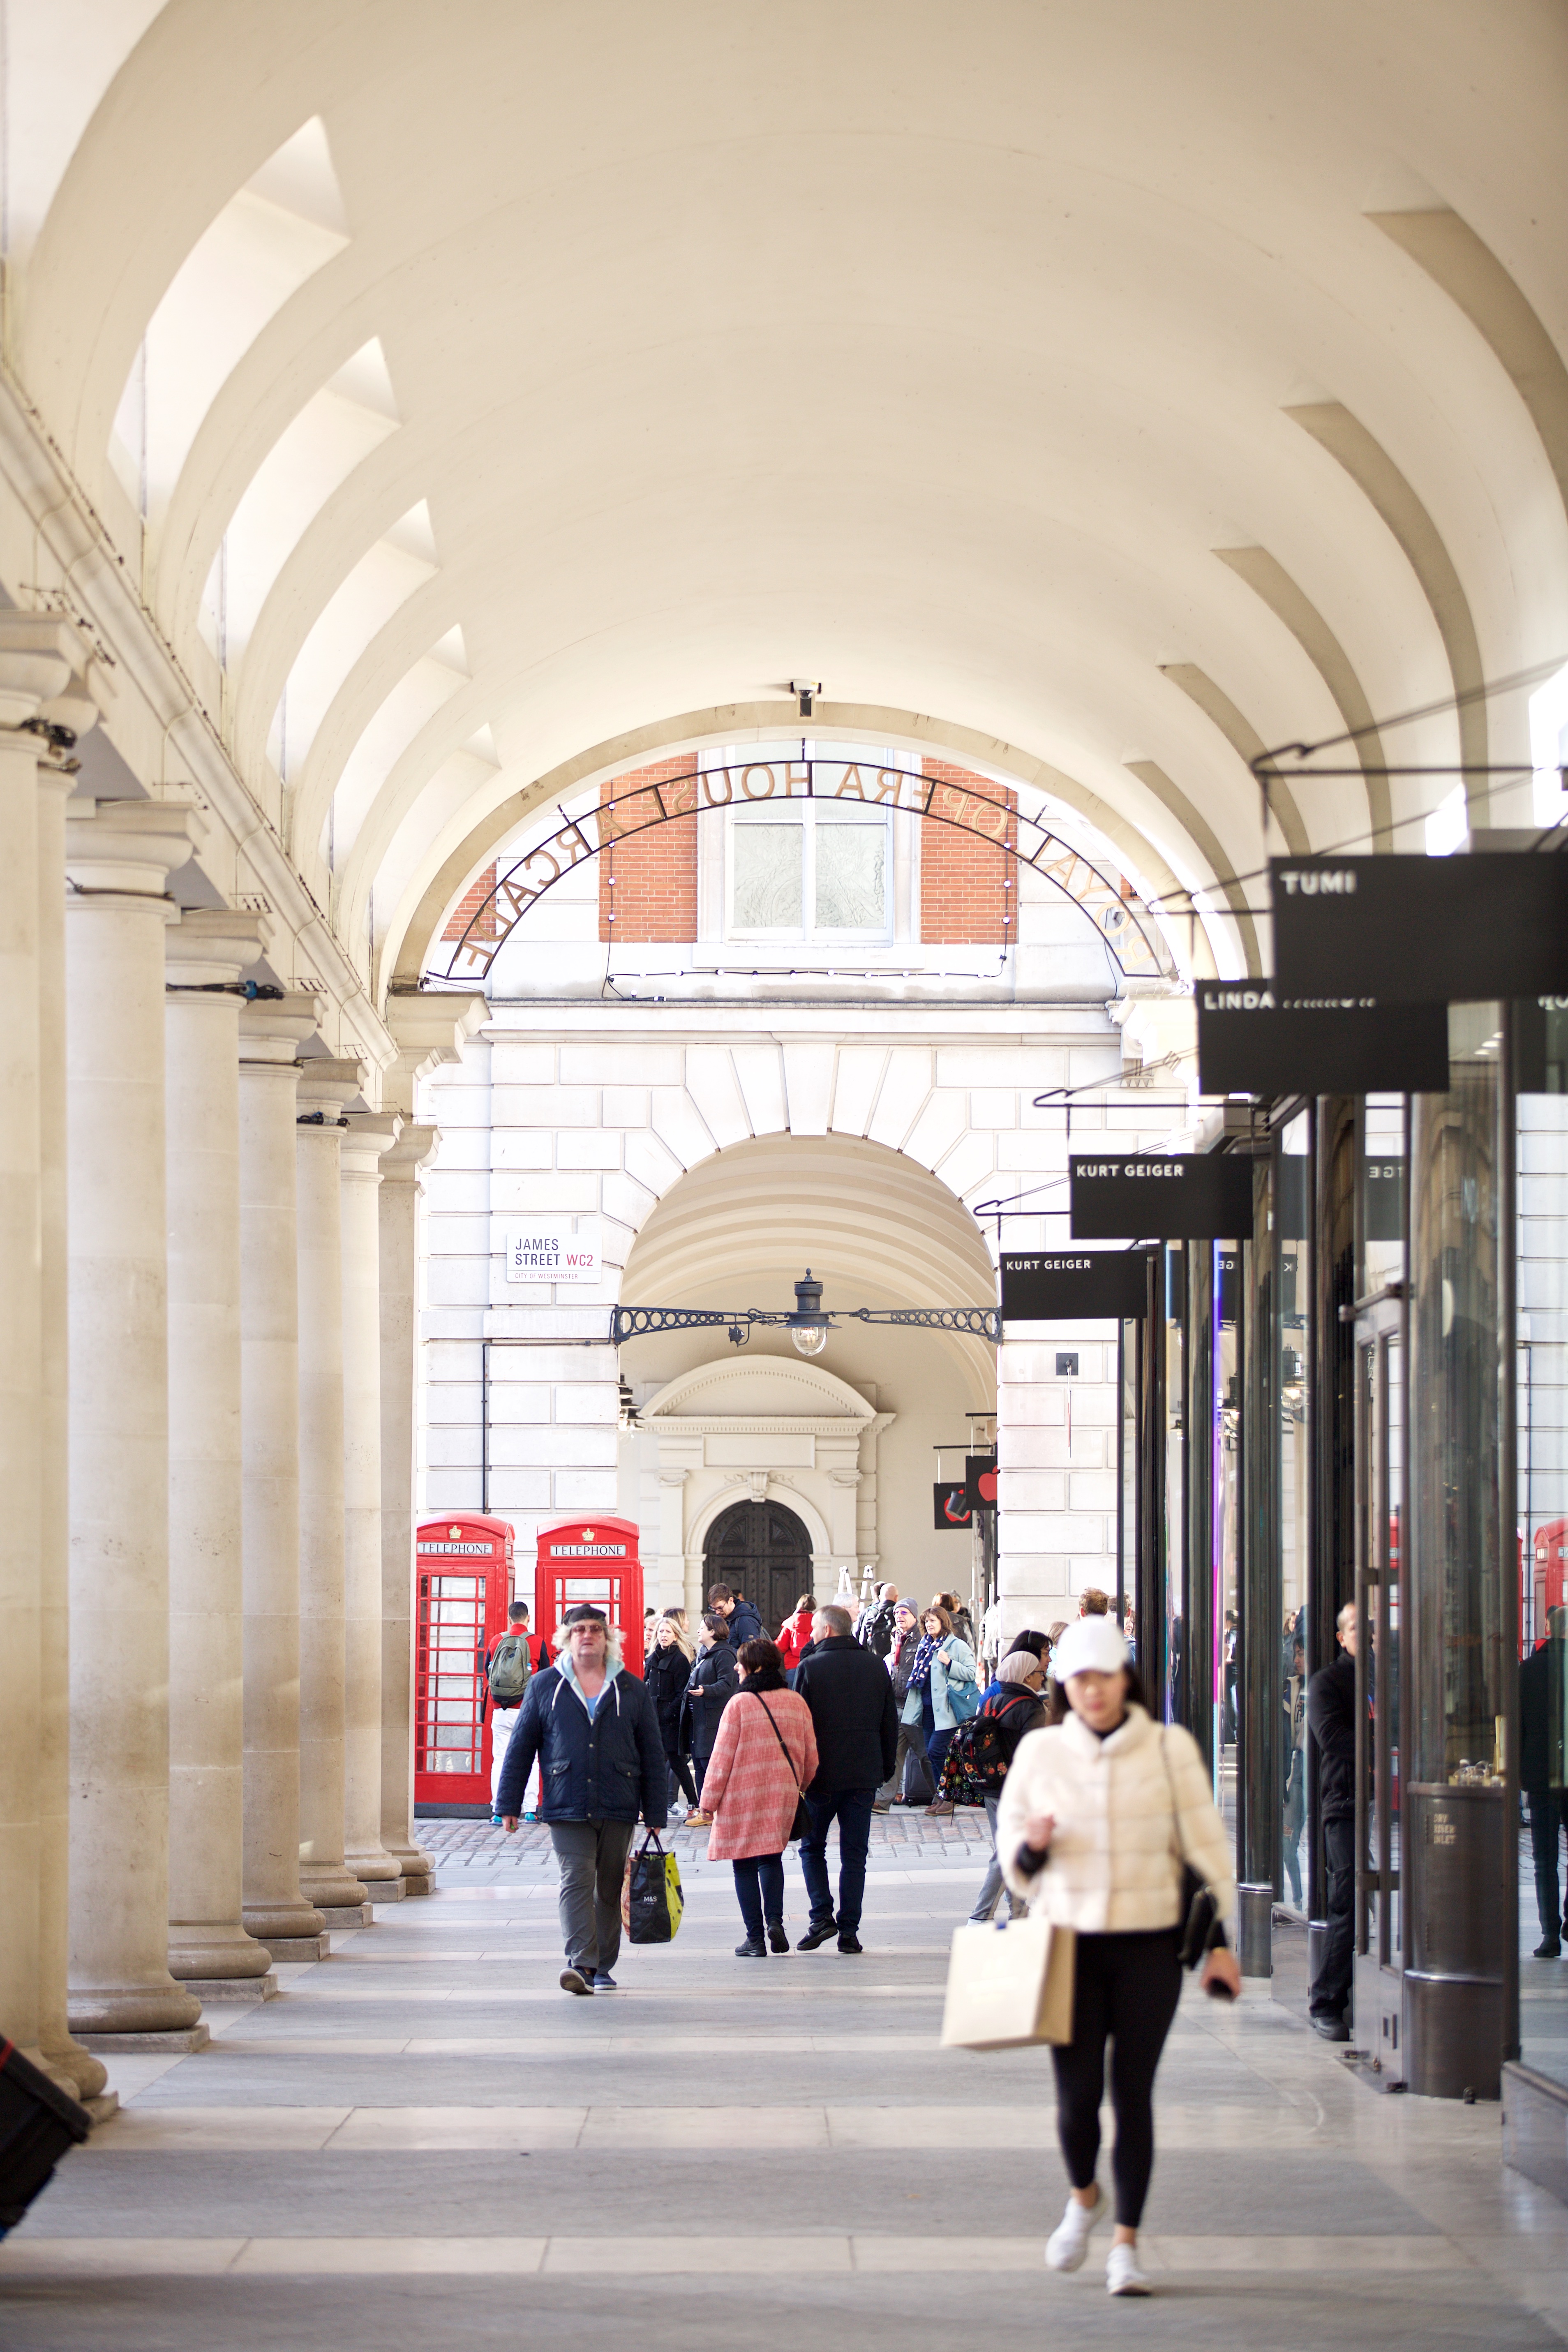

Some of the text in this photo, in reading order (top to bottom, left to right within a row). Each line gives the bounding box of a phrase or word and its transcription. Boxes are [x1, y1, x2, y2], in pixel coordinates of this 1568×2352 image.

[1280, 870, 1358, 895] TUMI
[1204, 991, 1275, 1010] LINDA
[1077, 1164, 1183, 1177] KURT GEIGER
[515, 1238, 559, 1250] JAMES
[515, 1253, 593, 1266] STREET WC2
[1006, 1259, 1091, 1271] KURT GEIGER
[420, 1543, 490, 1554] TELEPHONE
[552, 1546, 622, 1555] TELEPHONE
